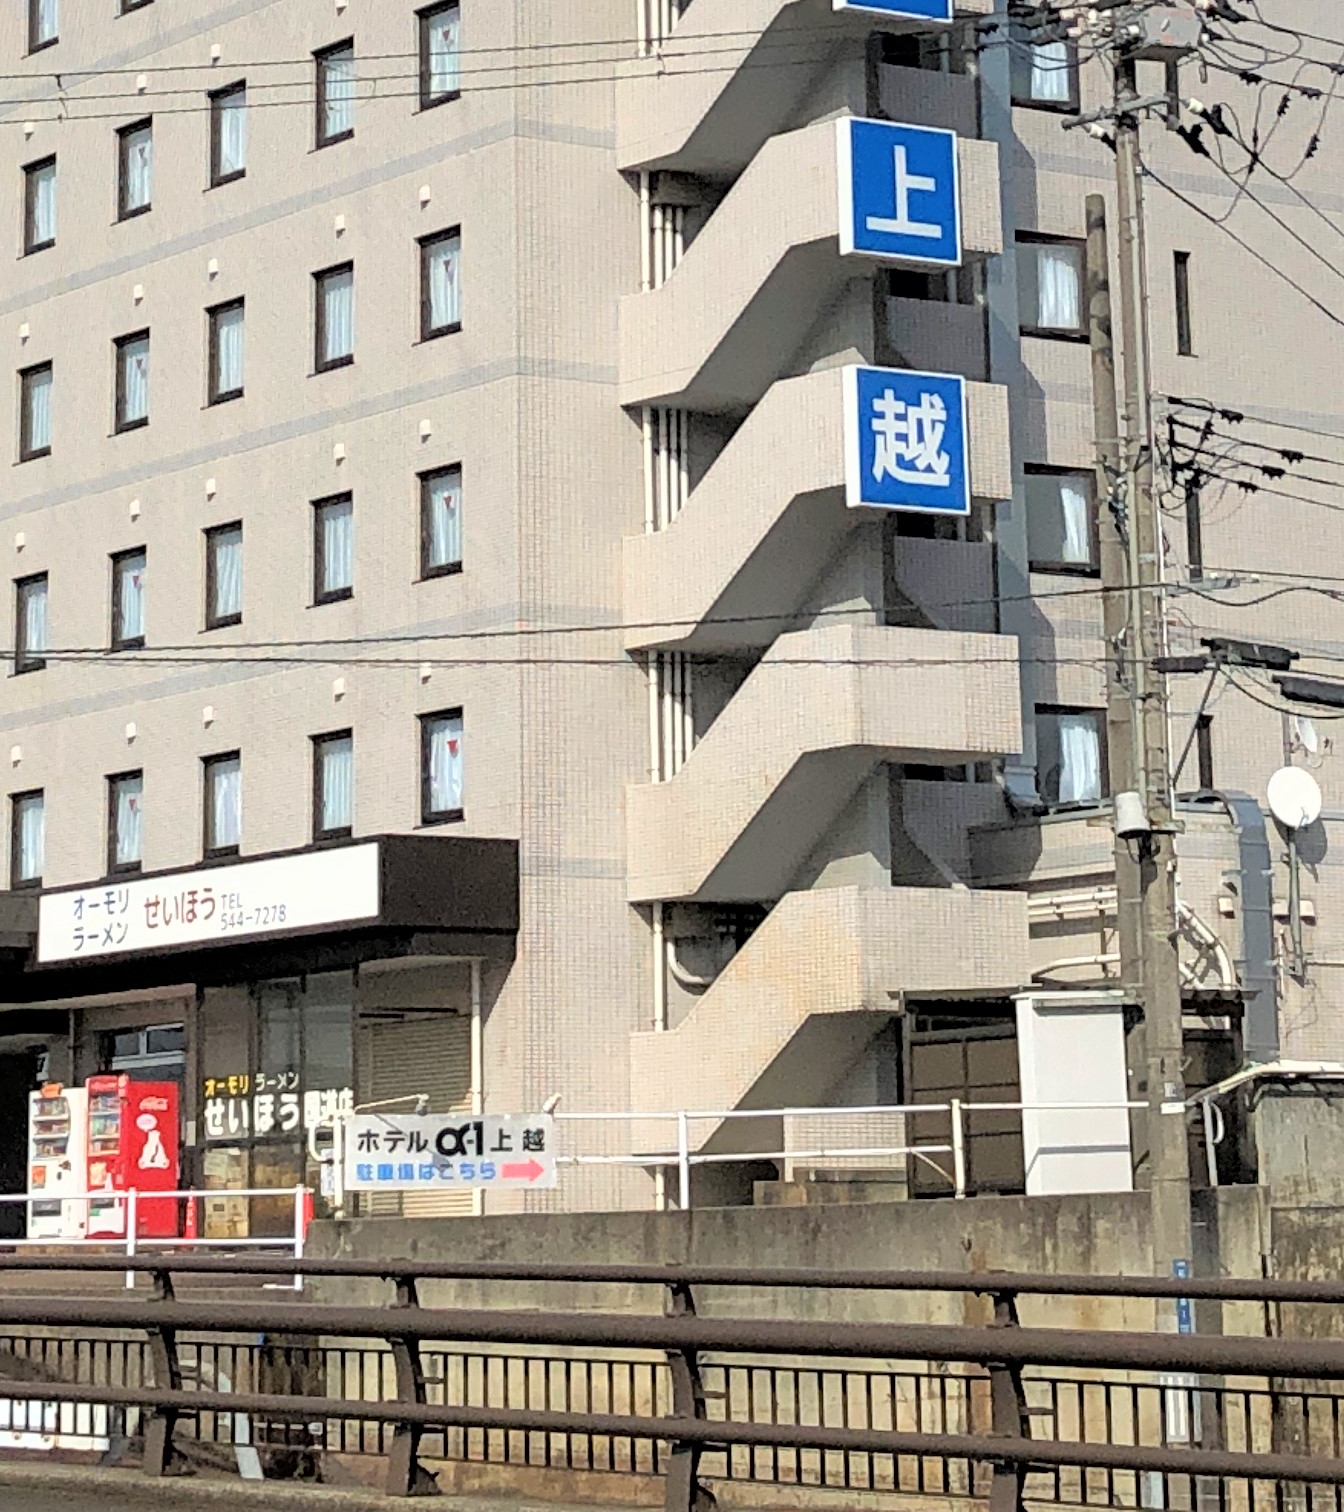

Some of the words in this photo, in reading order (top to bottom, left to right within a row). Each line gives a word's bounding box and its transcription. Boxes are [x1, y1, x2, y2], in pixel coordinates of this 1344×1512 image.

[73, 888, 129, 920] オーモリ
[144, 888, 216, 929] せいほう
[220, 892, 243, 910] TEL
[220, 904, 287, 931] 544-7278
[72, 923, 129, 951] ラーメン
[204, 1074, 250, 1097] オーモリ
[254, 1071, 299, 1092] ラーメン
